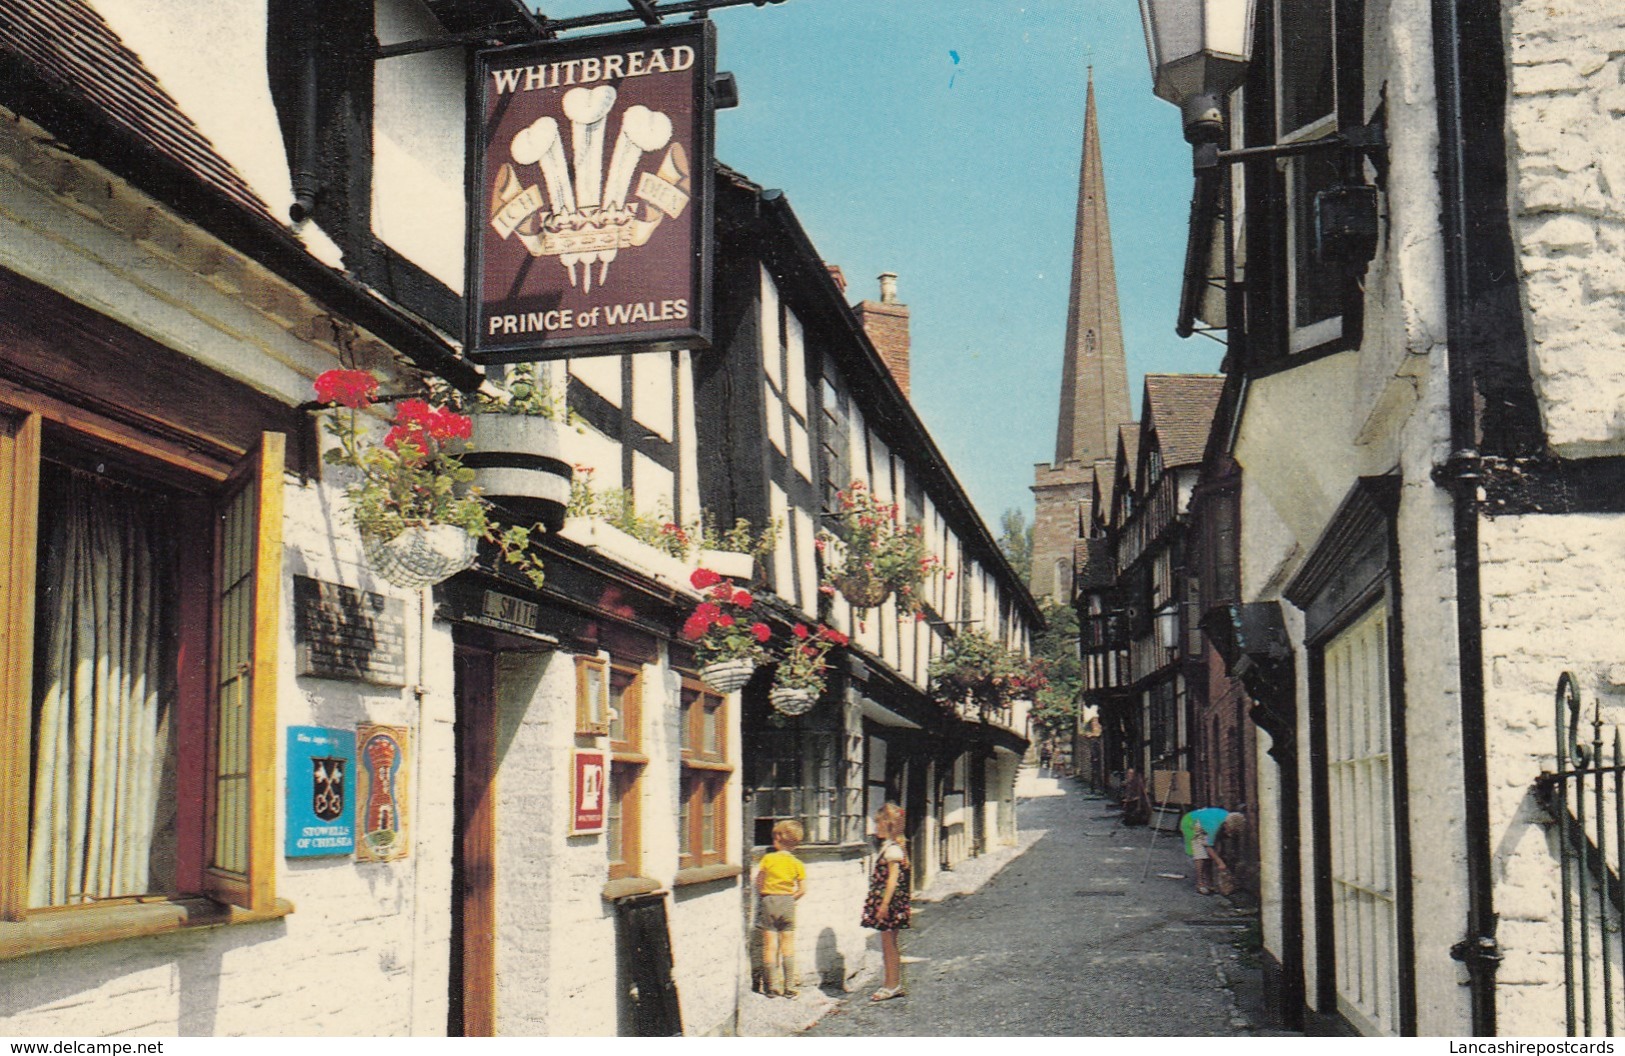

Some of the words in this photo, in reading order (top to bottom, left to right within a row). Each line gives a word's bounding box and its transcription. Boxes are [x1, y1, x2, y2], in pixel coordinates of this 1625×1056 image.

[491, 45, 695, 95] WHITBREAD
[489, 309, 573, 335] PRINCE
[577, 307, 599, 328] of
[604, 299, 688, 326] WALES
[297, 838, 311, 849] OF
[312, 836, 353, 848] CHELSEA
